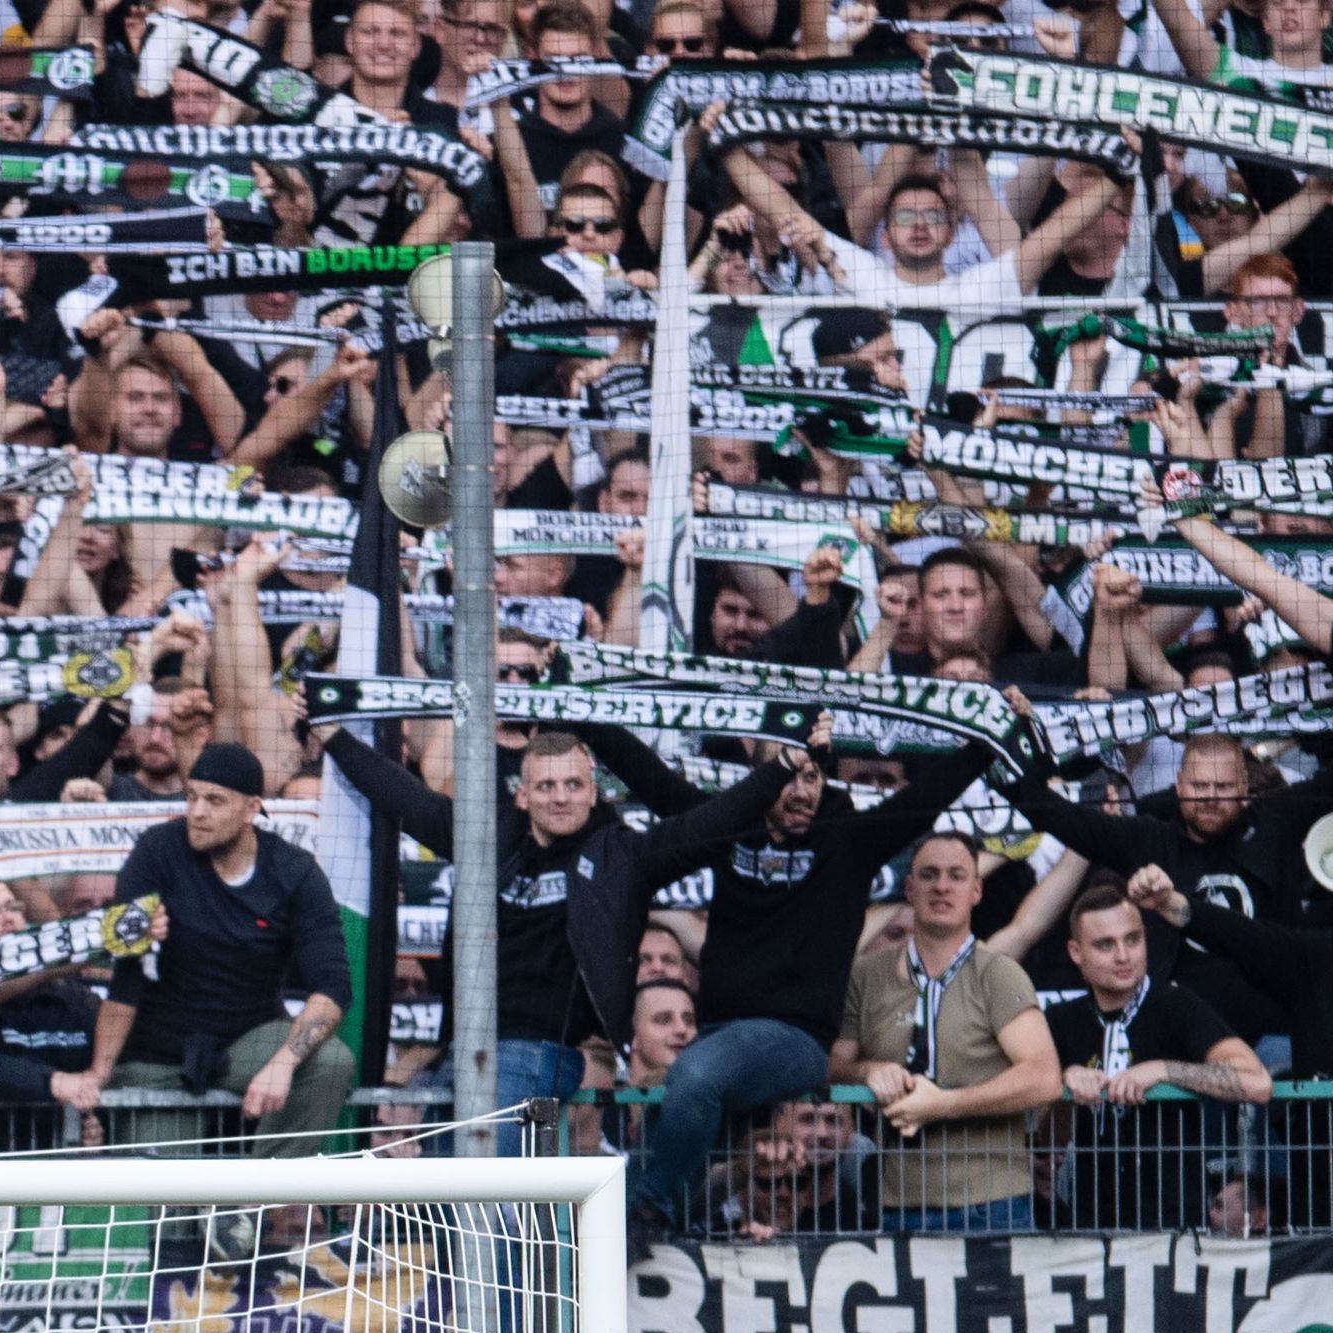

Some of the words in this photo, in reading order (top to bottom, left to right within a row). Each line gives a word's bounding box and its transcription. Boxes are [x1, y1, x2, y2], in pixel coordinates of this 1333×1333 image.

[807, 70, 922, 103] BORUSS
[166, 253, 230, 284] ICH
[236, 250, 301, 278] BIN
[358, 680, 766, 731] BEGEITSERVICE
